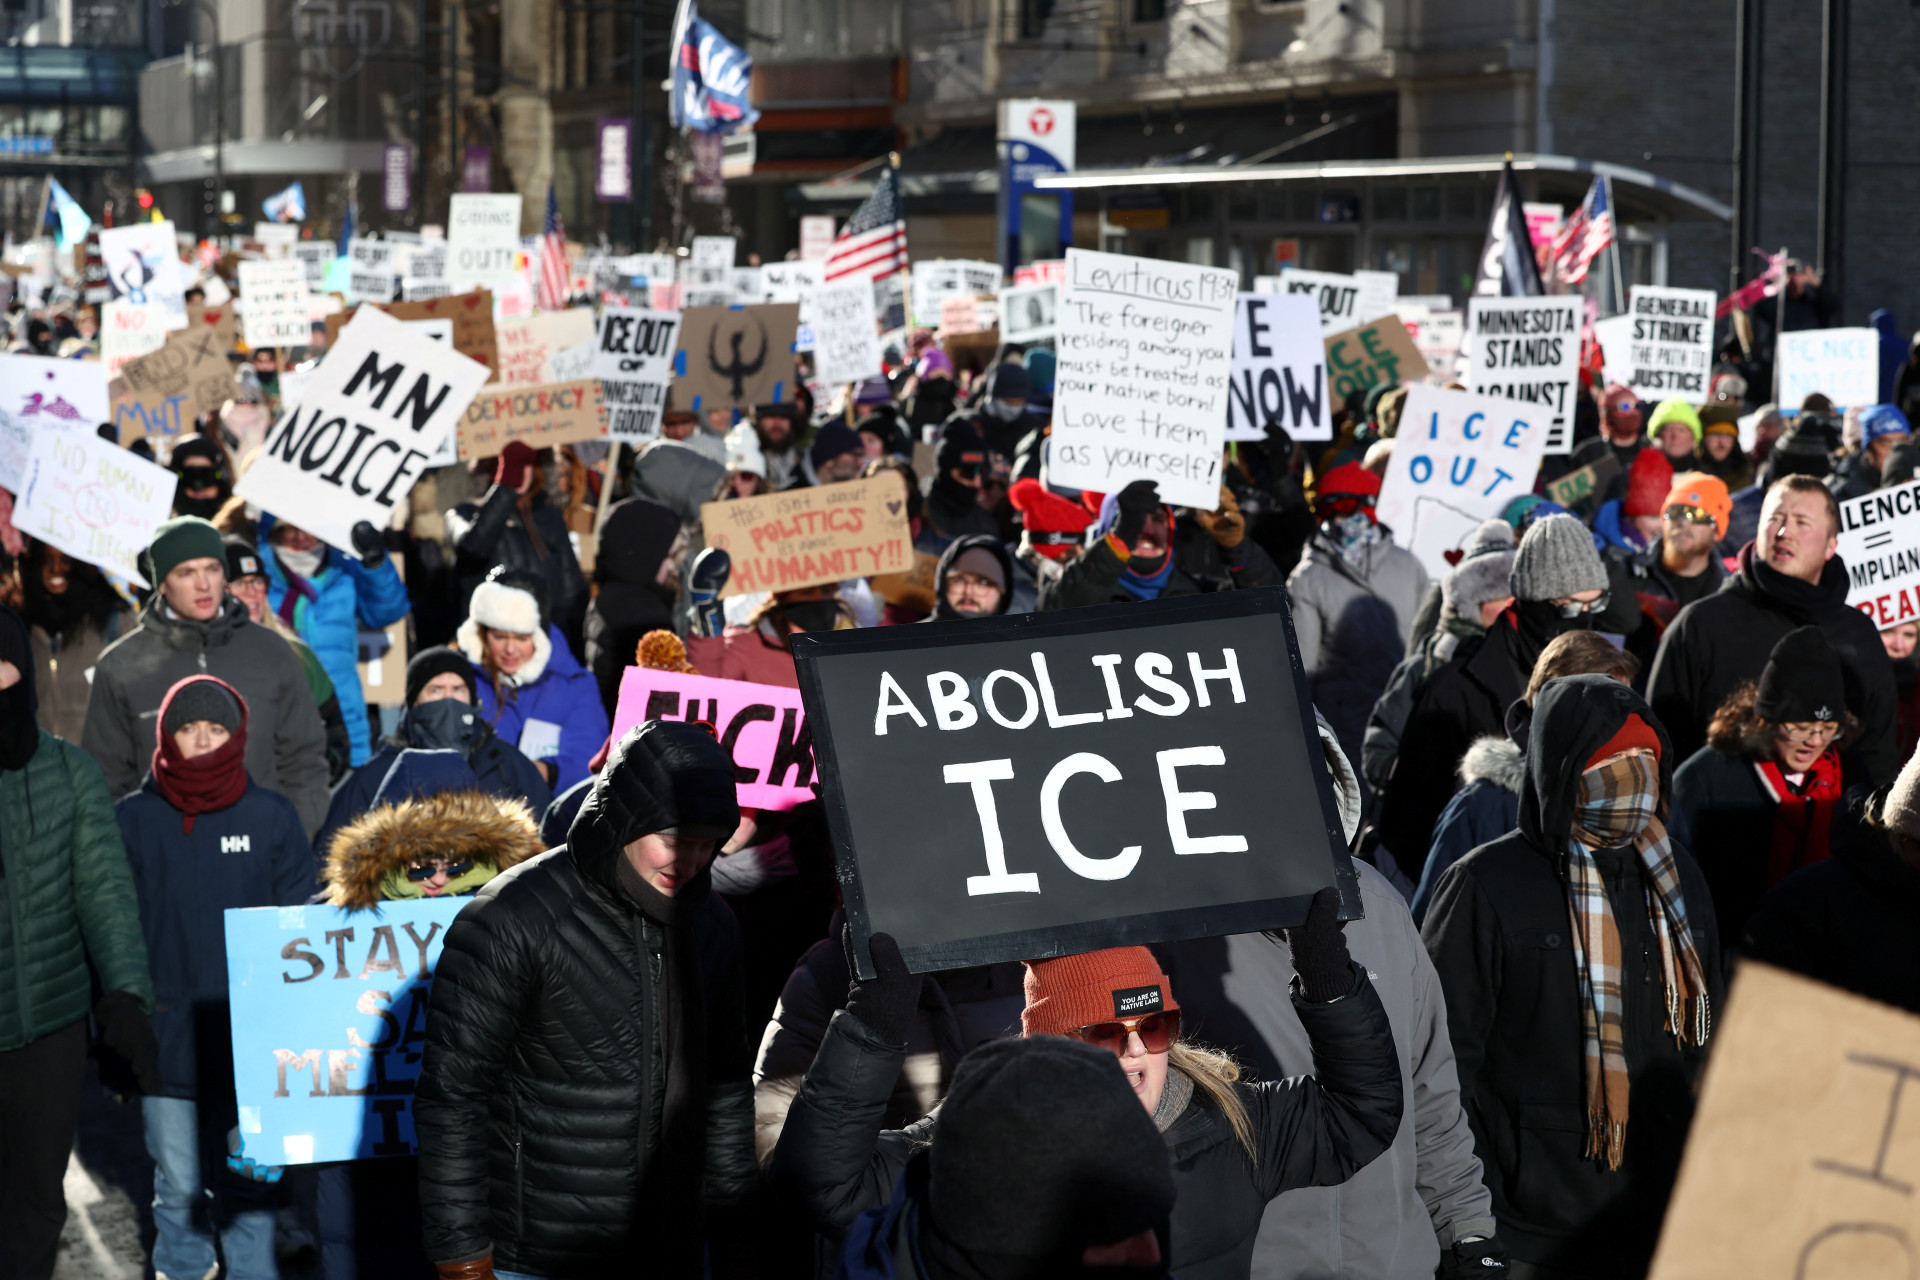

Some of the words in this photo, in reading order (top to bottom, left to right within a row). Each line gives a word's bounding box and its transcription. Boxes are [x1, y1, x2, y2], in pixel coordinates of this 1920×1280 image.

[1073, 256, 1194, 300] Leviticus
[1119, 303, 1212, 343] foreigner
[1478, 308, 1574, 334] MINNESOTA
[1636, 296, 1708, 319] GENERAL
[601, 315, 635, 353] ICE
[634, 318, 675, 357] OUT
[1061, 331, 1130, 361] residing
[1138, 340, 1191, 369] among
[1196, 347, 1225, 366] you
[1633, 319, 1702, 343] STRIKE
[1486, 338, 1563, 368] STANDS
[342, 351, 451, 432] MN
[1059, 359, 1103, 375] must
[1110, 361, 1130, 377] be
[1134, 362, 1199, 386] treated
[1205, 375, 1224, 389] as
[1628, 369, 1702, 391] JUSTICE
[467, 387, 584, 424] DEMOCRACY
[1058, 378, 1097, 397] your
[1104, 381, 1160, 401] native
[1166, 386, 1215, 413] born!
[1227, 364, 1322, 428] NOW
[1477, 381, 1569, 413] INST
[1062, 404, 1126, 433] Love
[1136, 409, 1207, 446] them
[1429, 412, 1530, 448] ICE
[53, 437, 87, 474] NO
[1059, 444, 1092, 467] as
[1409, 455, 1513, 496] OUT
[1840, 486, 1920, 532] LENC
[750, 507, 866, 552] POLITICS
[730, 539, 903, 592] HUMANITY!!
[1851, 548, 1920, 589] MPLIAN
[874, 648, 1246, 736] ABOLISH
[943, 745, 1249, 897] ICE
[220, 835, 250, 853] HH
[281, 921, 443, 984] STAY
[1120, 1000, 1143, 1010] NATIVE
[1144, 997, 1159, 1005] LAND
[1121, 996, 1136, 1004] YOU
[1137, 992, 1148, 1001] ARE
[273, 1048, 422, 1098] MEL
